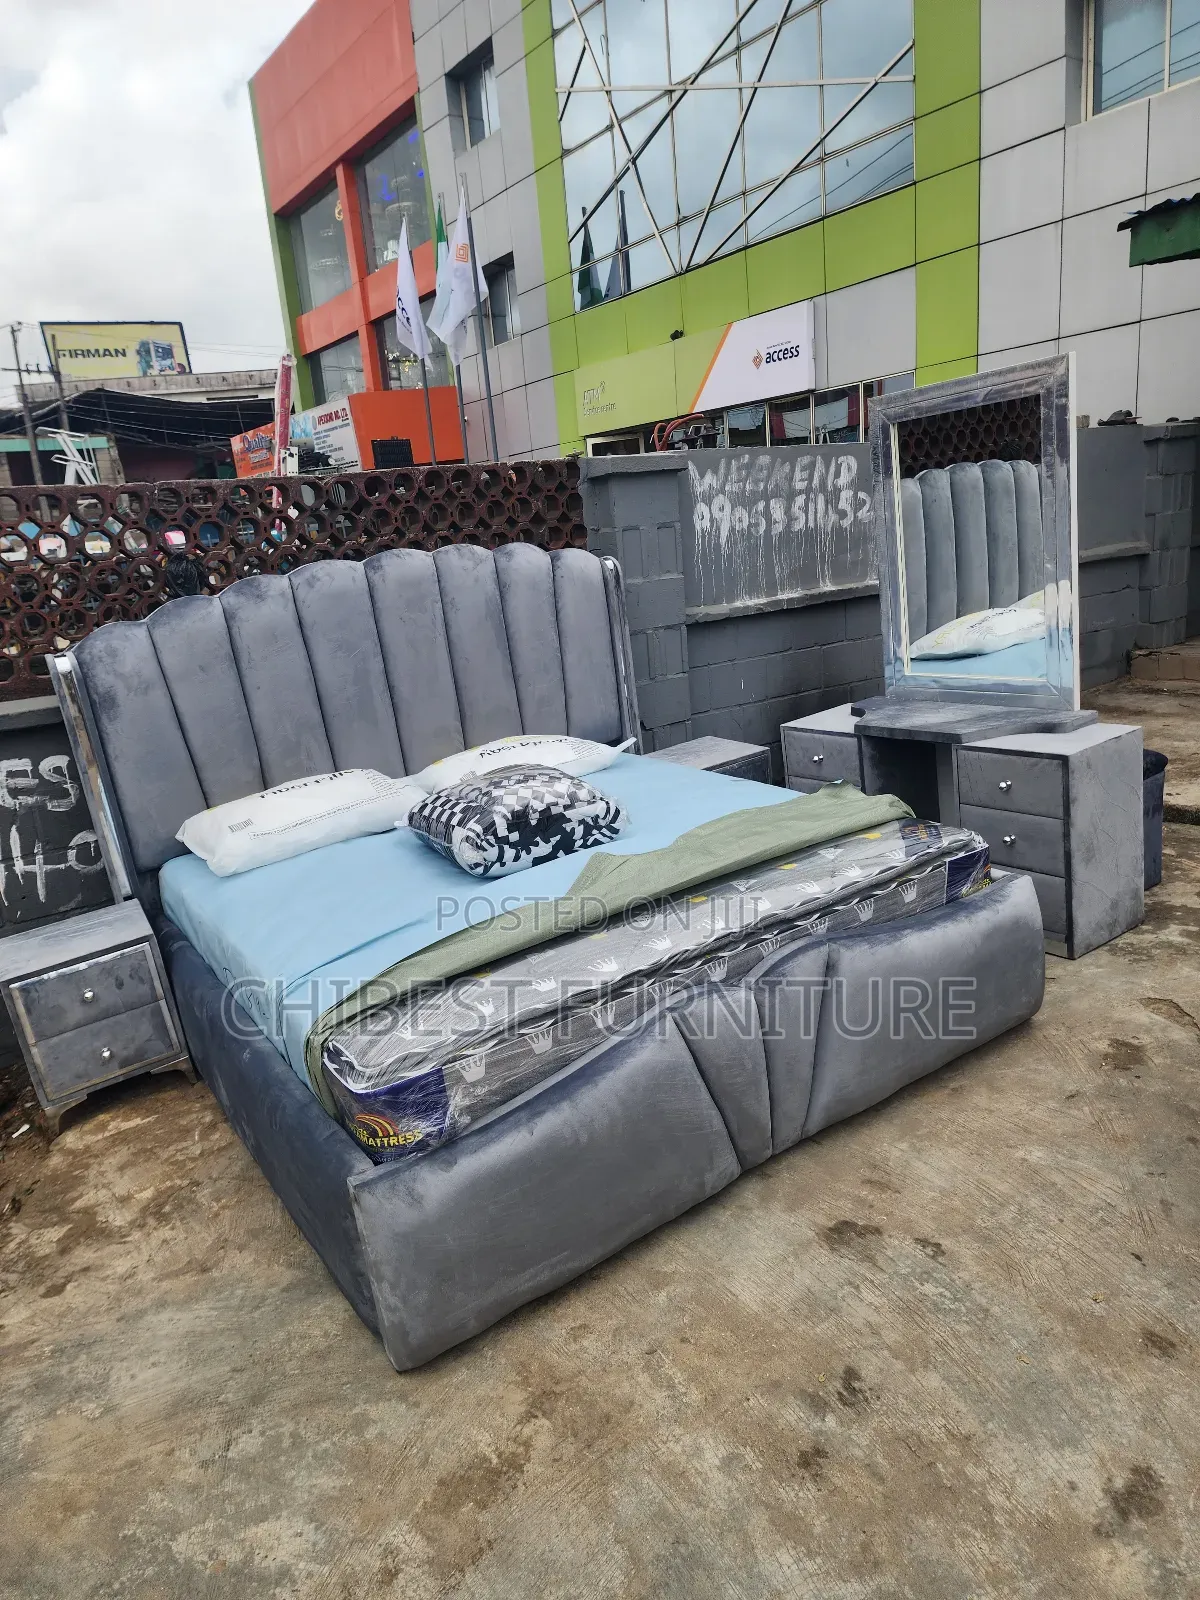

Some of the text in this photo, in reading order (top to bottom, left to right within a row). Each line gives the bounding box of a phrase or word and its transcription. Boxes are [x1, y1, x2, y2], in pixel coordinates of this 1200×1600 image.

[57, 348, 127, 359] FIRMAN
[765, 345, 800, 364] access
[688, 454, 858, 492] WEEKEND
[360, 1129, 424, 1148] MATTRESS
